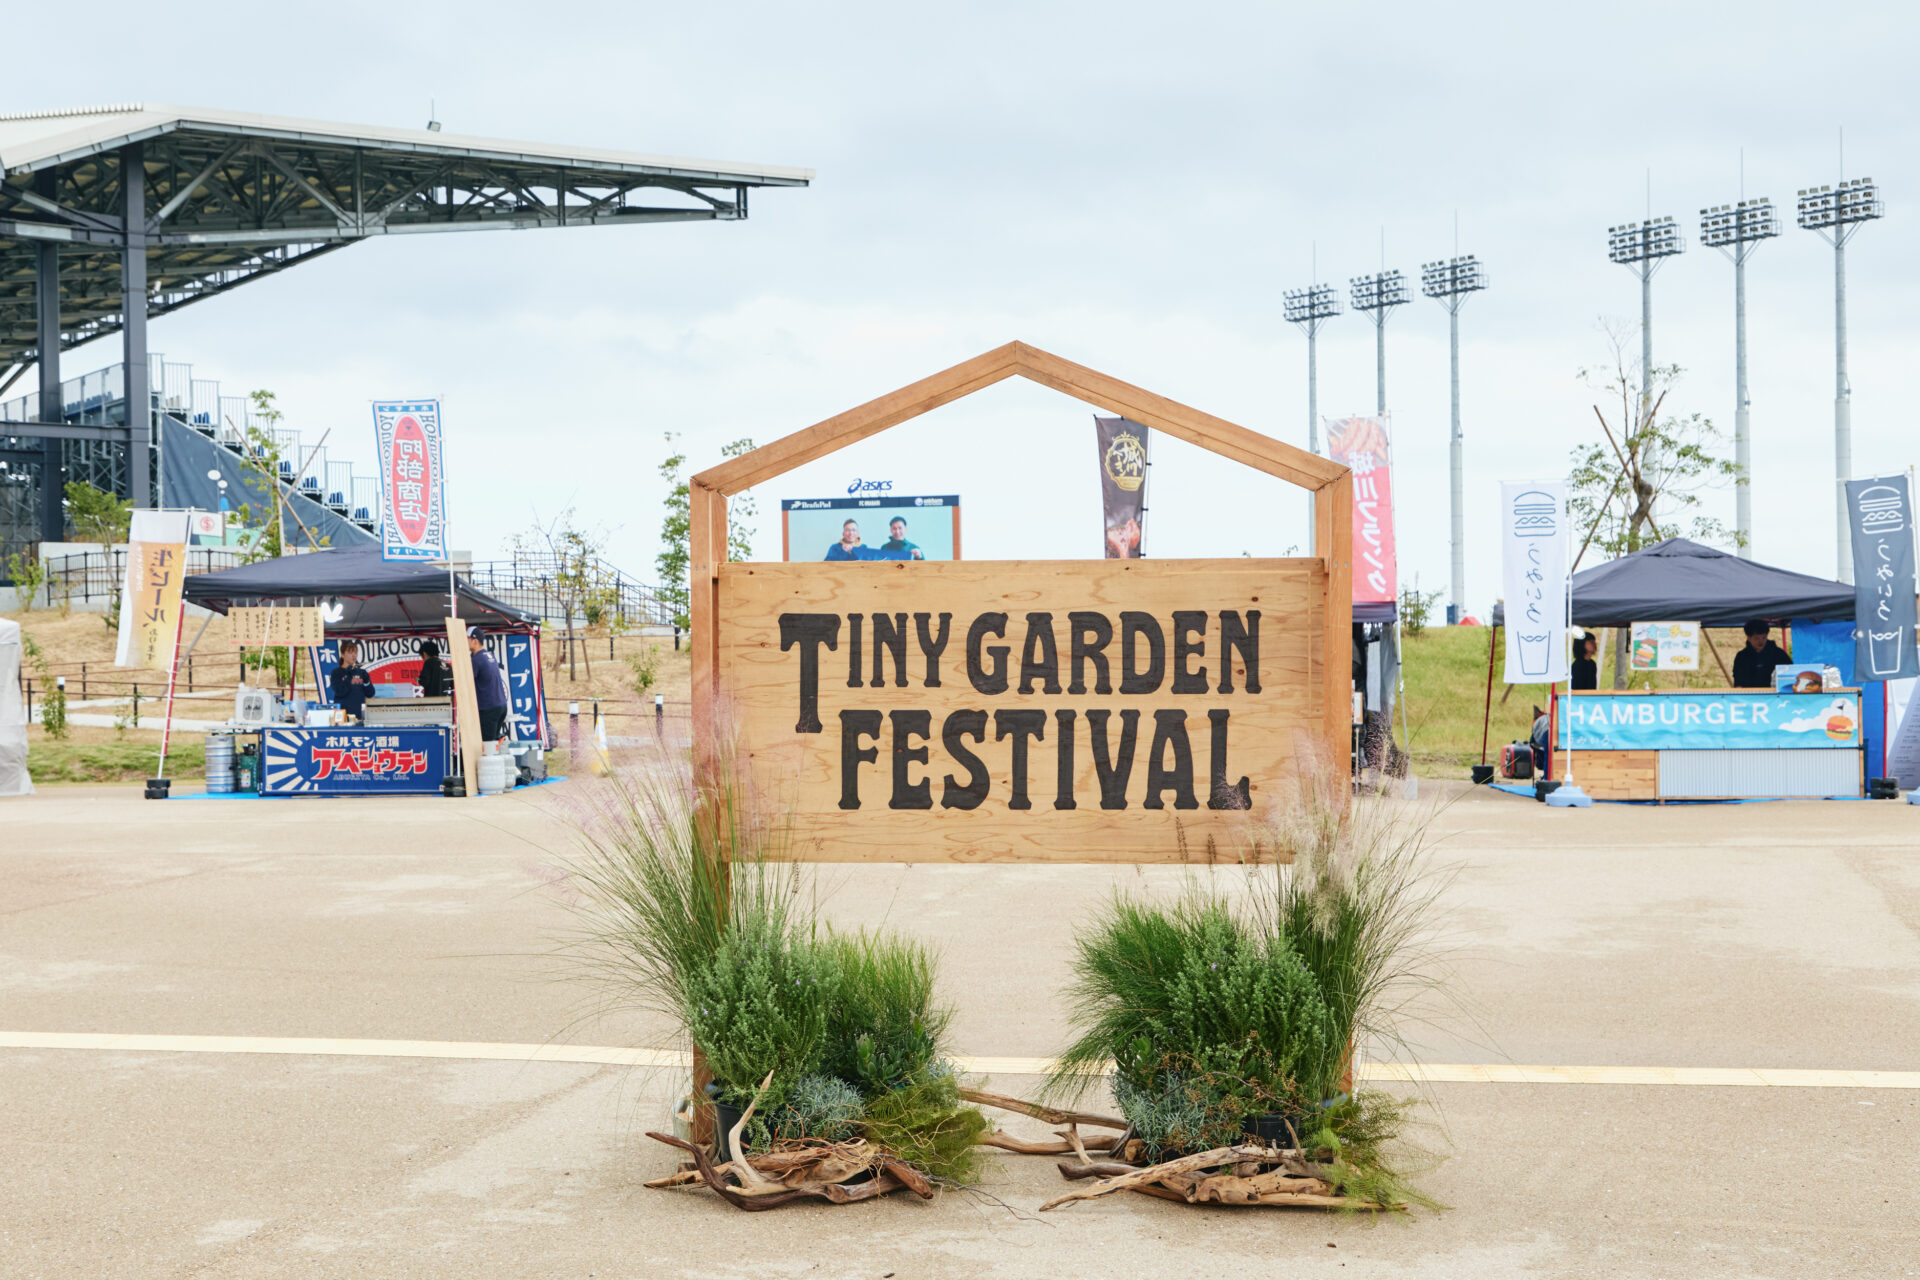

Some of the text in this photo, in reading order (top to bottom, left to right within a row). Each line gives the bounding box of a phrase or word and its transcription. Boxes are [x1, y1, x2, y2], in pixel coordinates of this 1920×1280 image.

[508, 643, 537, 737] アブリヤ
[778, 610, 1262, 733] TINY GARDEN
[1566, 702, 1770, 725] HAMBURGER
[310, 745, 428, 780] アベショウテン
[837, 709, 1253, 811] FESTIVAL
